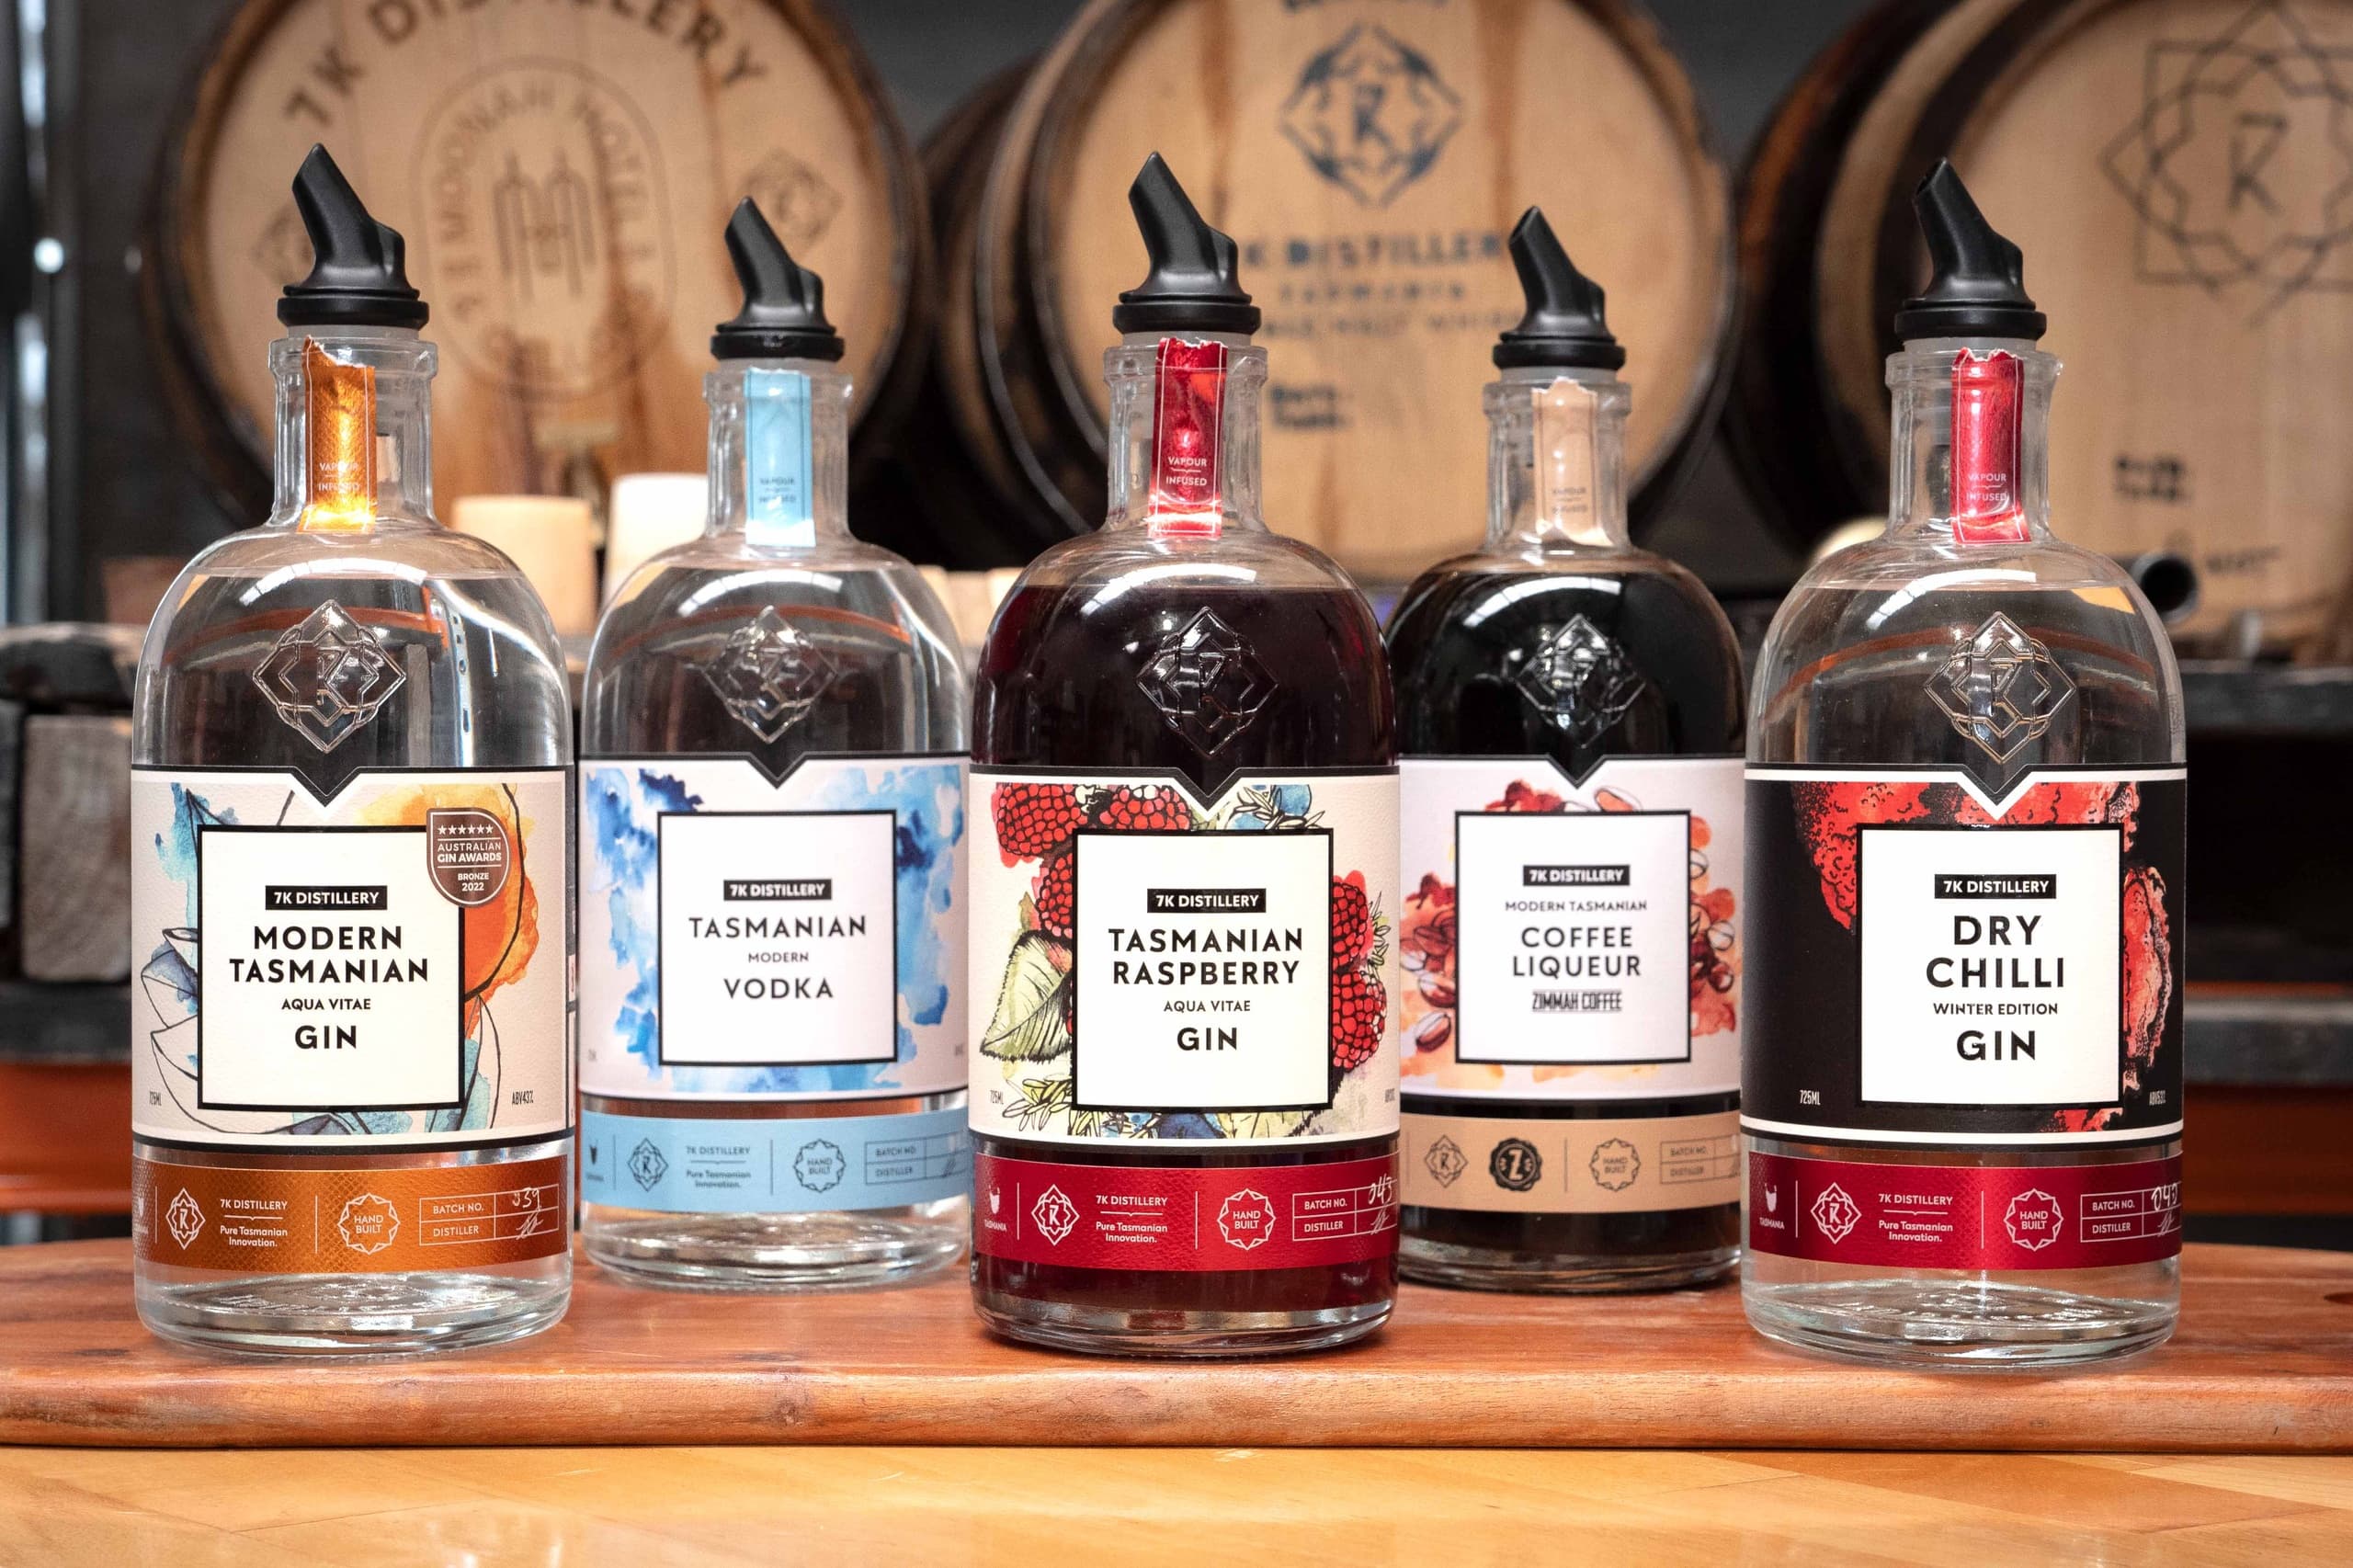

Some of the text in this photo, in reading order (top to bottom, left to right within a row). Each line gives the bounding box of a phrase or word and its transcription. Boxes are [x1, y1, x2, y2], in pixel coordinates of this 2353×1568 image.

[1167, 456, 1207, 467] VAPOUR
[1165, 476, 1207, 485] INFUSED
[1969, 472, 2007, 482] VAPOUR
[1967, 492, 2006, 501] INFUSED
[438, 841, 502, 853] AUSTRALIAN
[438, 851, 502, 863] GIN AWARDS
[458, 872, 489, 881] BRONZE
[1529, 869, 1624, 882] 7K DISTILLERY
[461, 882, 485, 892] 2022
[730, 882, 825, 897] 7K DISTILLERY
[1943, 881, 2050, 894] 7K DISTILLERY
[274, 892, 379, 905] 7K DISTILLERY
[1155, 893, 1261, 908] 7K DISTILLERY
[1506, 901, 1647, 912] MODERN TASMANIAN
[689, 915, 866, 939] TASMANIAN
[1954, 915, 2042, 946] DRY
[254, 926, 403, 950] MODERN
[1108, 927, 1302, 953] TASMANIAN
[1521, 926, 1632, 948] COFFEE
[748, 952, 809, 963] MODERN
[230, 959, 428, 983] TASMANIAN
[1113, 961, 1300, 985] RASPBERRY
[1513, 956, 1642, 978] LIQUEUR
[1926, 957, 2064, 989] CHILLI
[723, 977, 834, 999] VODKA
[281, 998, 371, 1011] AQUA VITAE
[1164, 1000, 1251, 1014] AQUA VITAE
[1531, 991, 1622, 1012] ZIMMAH COFFEE
[1933, 1003, 2059, 1016] WINTER EDITION
[294, 1026, 358, 1050] GIN
[1176, 1028, 1238, 1051] GIN
[1956, 1031, 2037, 1061] GIN
[1800, 1090, 1820, 1105] 725ML
[699, 1145, 750, 1155] DISTILLERY
[807, 1158, 833, 1167] HAND
[221, 1199, 289, 1210] 7K DISTILLERY
[1096, 1195, 1167, 1207] 7K DISTILLERY
[1304, 1198, 1347, 1210] BATCH NO.
[1879, 1193, 1953, 1206] 7K DISTILLERY
[2092, 1199, 2135, 1211] BATCH NO.
[433, 1202, 483, 1215] BATCH NO.
[354, 1215, 384, 1225] HAND
[1233, 1211, 1261, 1221] HAND
[2020, 1210, 2048, 1221] HAND
[221, 1225, 289, 1237] Pure Tasmanian
[355, 1224, 381, 1234] BUILT
[433, 1226, 479, 1237] DISTILLER
[1096, 1222, 1167, 1233] Pure Tasmanian
[1234, 1221, 1259, 1230] BUILT
[1304, 1221, 1344, 1232] DISTILLER
[1879, 1221, 1953, 1232] Pure Tasmanian
[2022, 1221, 2047, 1231] BUILT
[2092, 1222, 2131, 1233] DISTILLER
[229, 1237, 278, 1247] Innovation.
[1106, 1233, 1157, 1243] Innovation.
[1889, 1232, 1942, 1243] Innovation.
